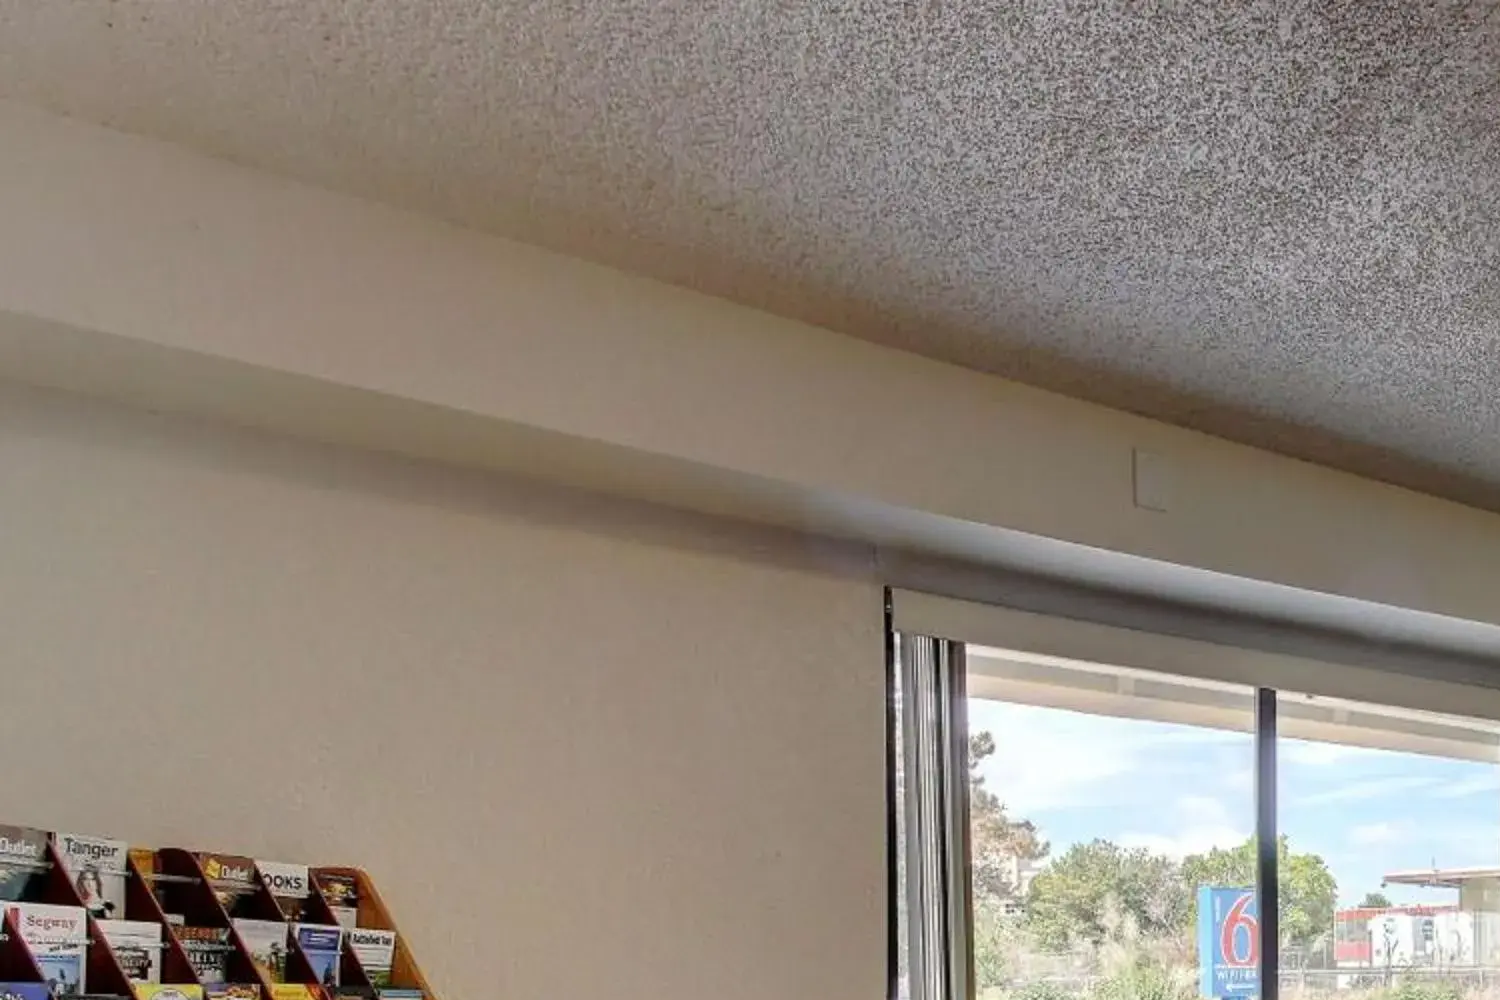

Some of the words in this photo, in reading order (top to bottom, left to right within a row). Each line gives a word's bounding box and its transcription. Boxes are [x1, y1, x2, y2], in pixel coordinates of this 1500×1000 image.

[64, 837, 119, 860] Tanger
[263, 873, 303, 890] OOKS
[27, 915, 77, 931] Segway
[1220, 891, 1259, 969] 6
